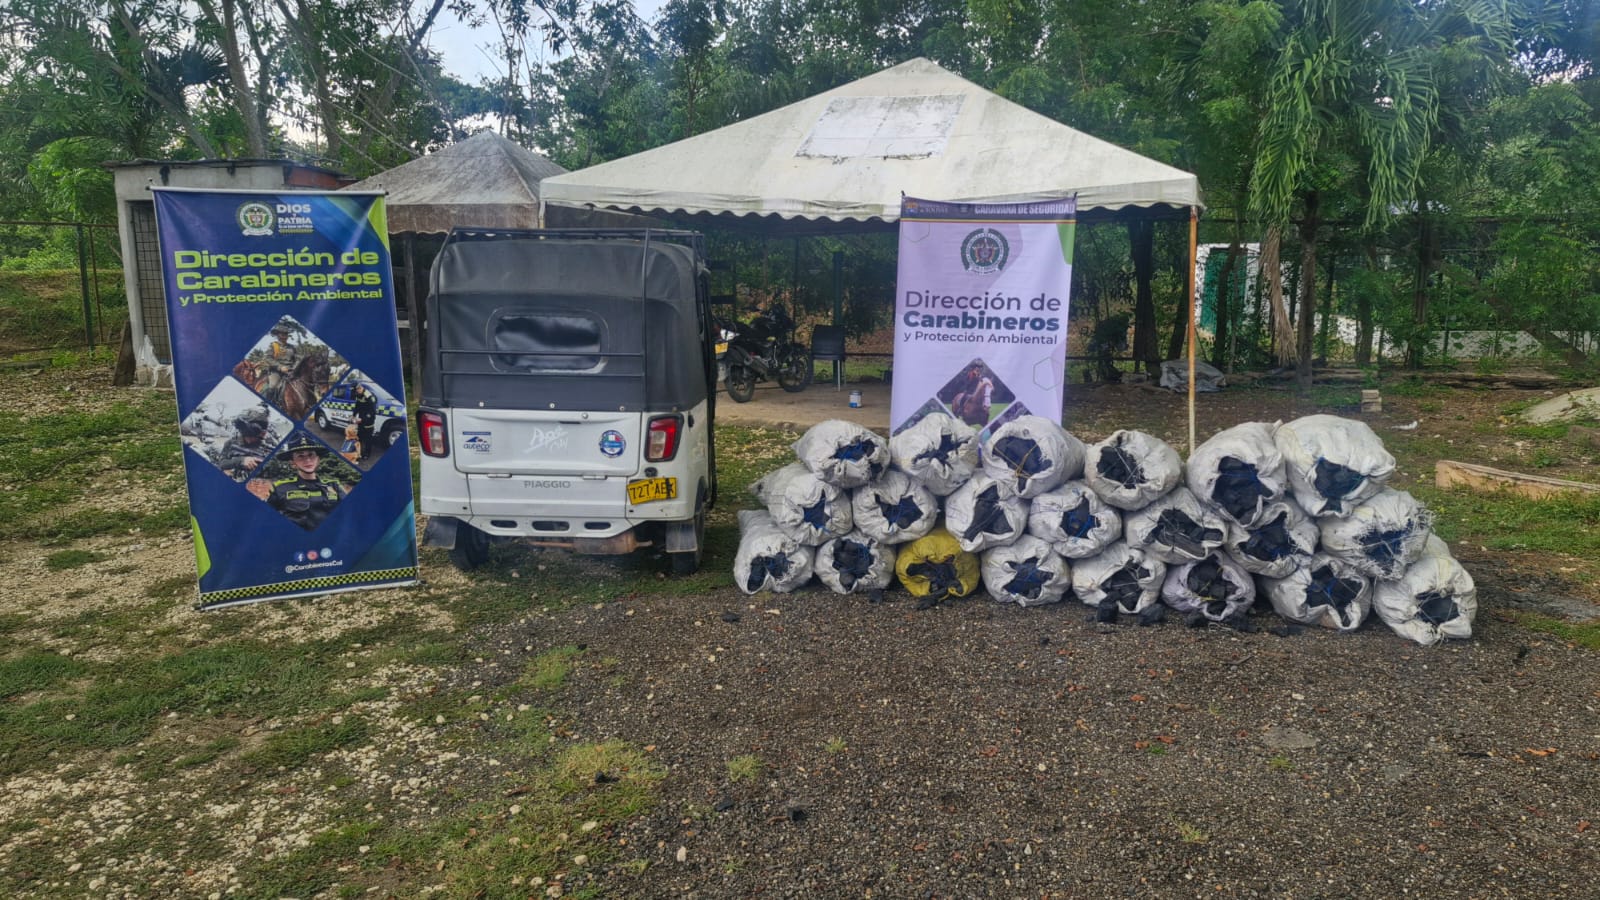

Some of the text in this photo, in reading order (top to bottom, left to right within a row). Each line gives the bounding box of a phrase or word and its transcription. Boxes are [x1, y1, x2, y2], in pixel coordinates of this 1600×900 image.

[276, 204, 312, 214] DIOS
[975, 203, 1075, 214] CARAVANA DE SEGURIDAD
[277, 216, 313, 225] PATRIA
[174, 246, 379, 269] Dirección de
[176, 270, 382, 290] Carabineros
[179, 288, 383, 307] y Protección Ambiental
[905, 290, 1061, 311] Dirección de
[904, 311, 1059, 331] Carabineros
[903, 330, 1057, 344] y Protección Ambiental
[524, 480, 571, 489] PIAGGIO
